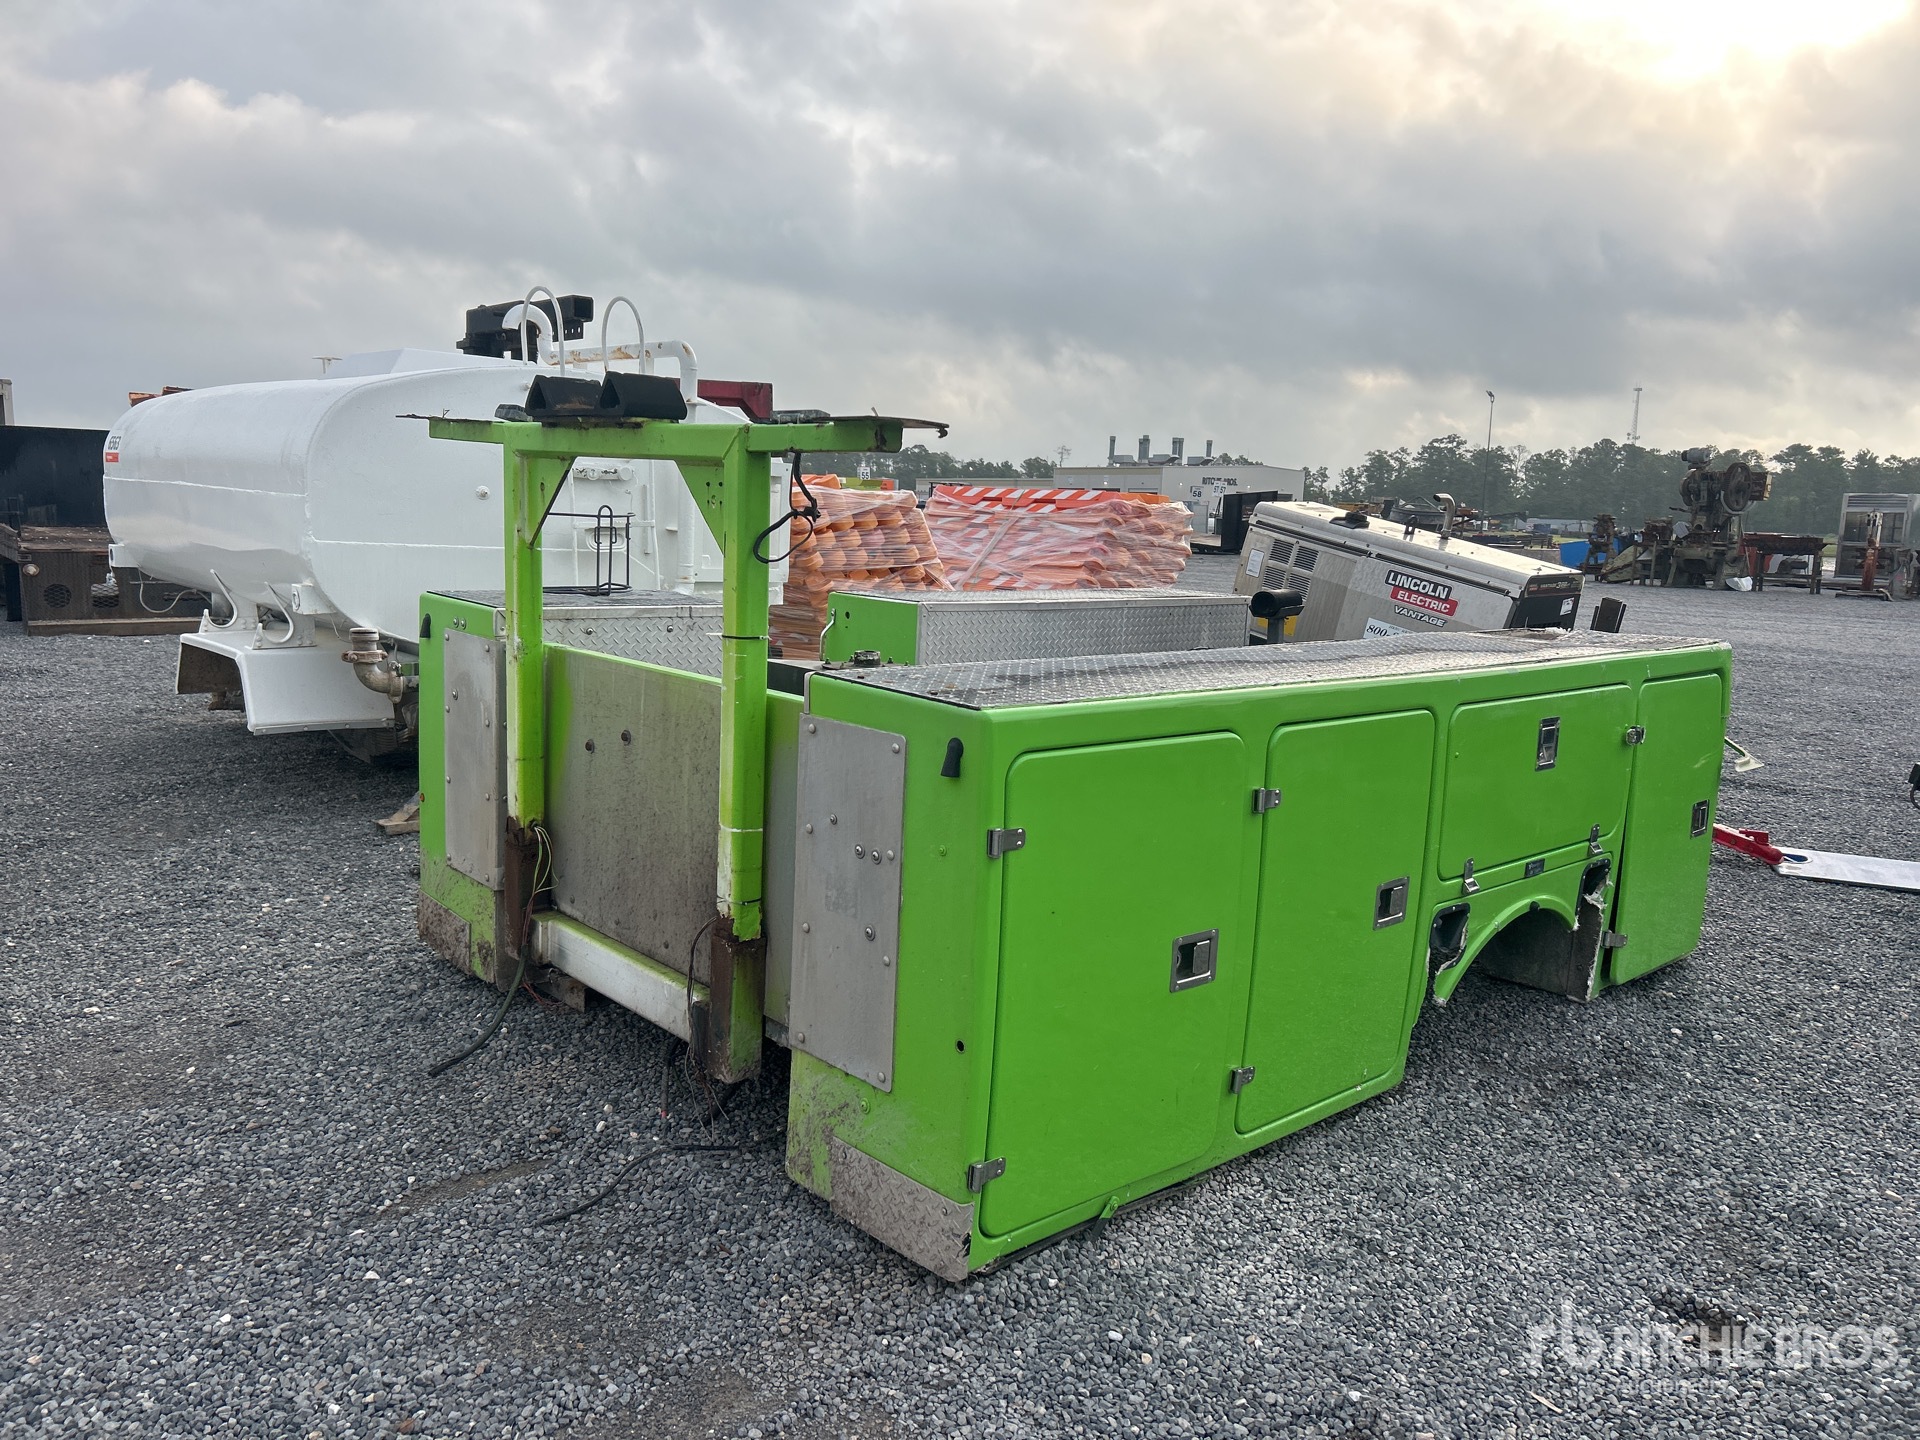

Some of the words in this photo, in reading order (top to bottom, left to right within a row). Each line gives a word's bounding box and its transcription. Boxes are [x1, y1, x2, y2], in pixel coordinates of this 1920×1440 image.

[861, 471, 870, 480] 55
[1192, 490, 1202, 498] 58
[1387, 572, 1449, 600] LINCOLN
[1397, 590, 1450, 613] ELECTRIC
[1394, 605, 1447, 628] VANTAGE
